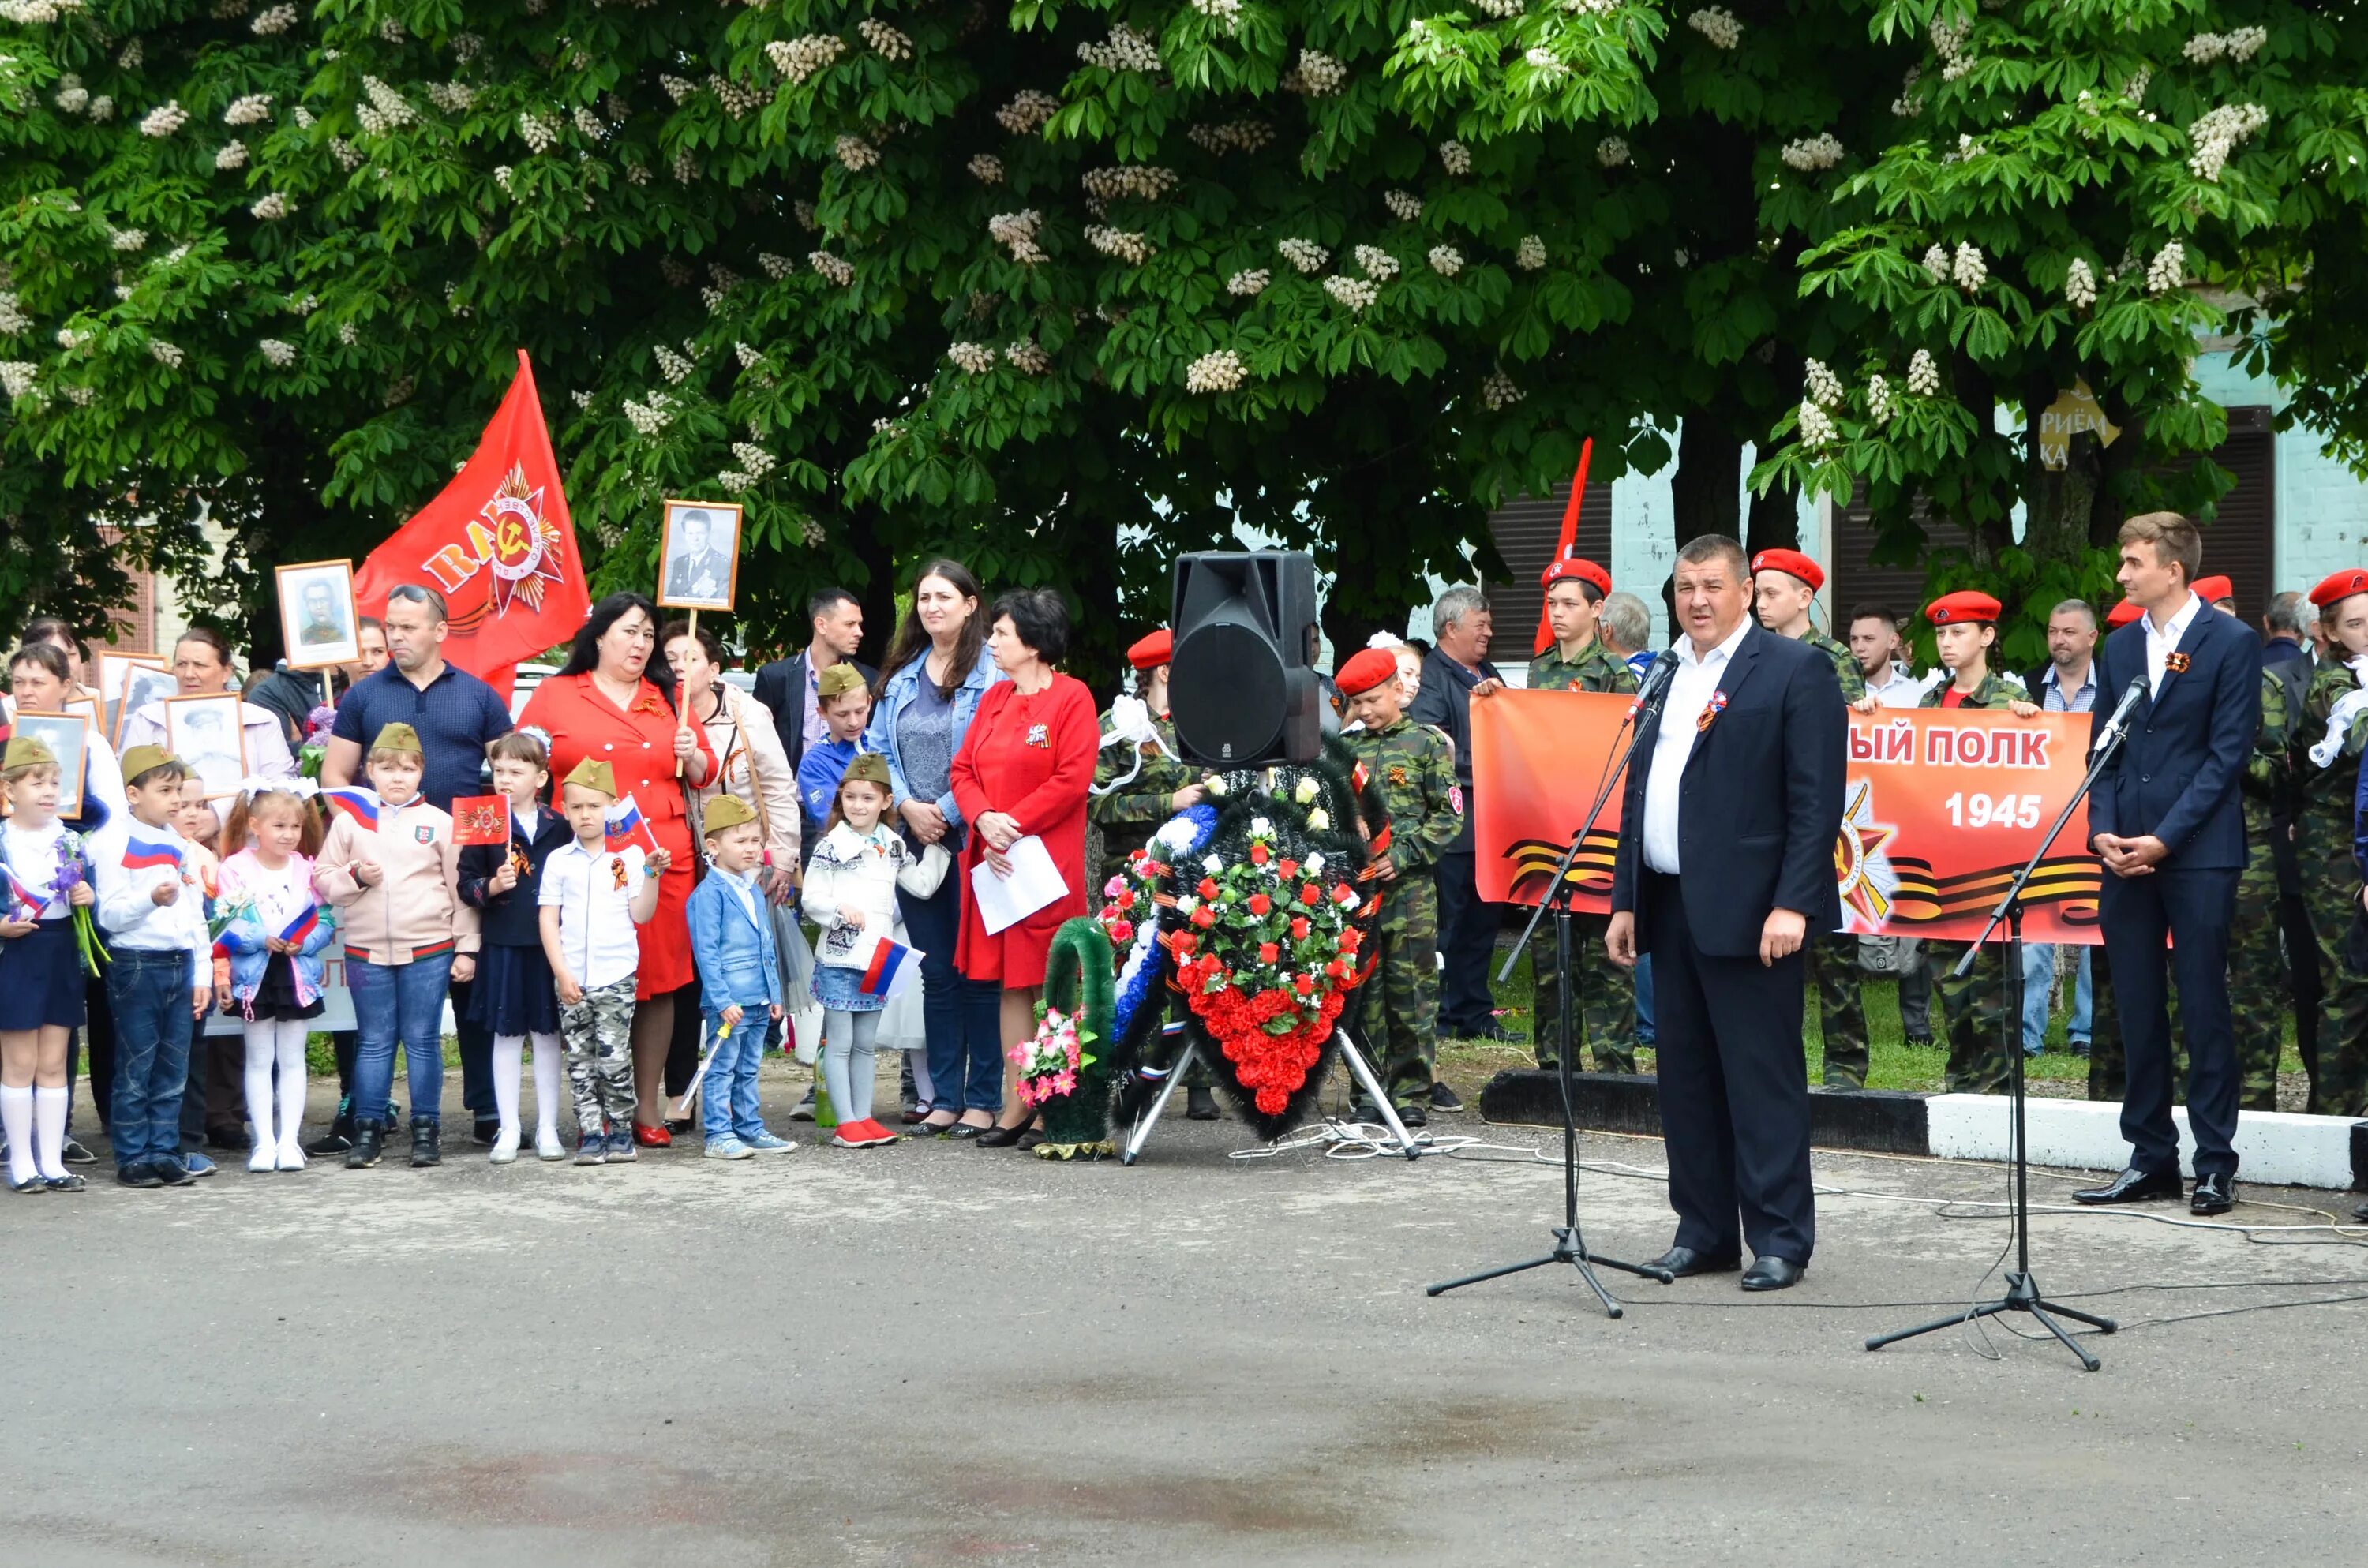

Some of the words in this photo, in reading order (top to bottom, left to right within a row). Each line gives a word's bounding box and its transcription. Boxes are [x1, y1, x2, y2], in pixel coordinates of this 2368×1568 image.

[1850, 721, 1913, 762] ЫЙ
[1928, 730, 2048, 765] ПОЛК
[1945, 791, 2042, 829] 1945
